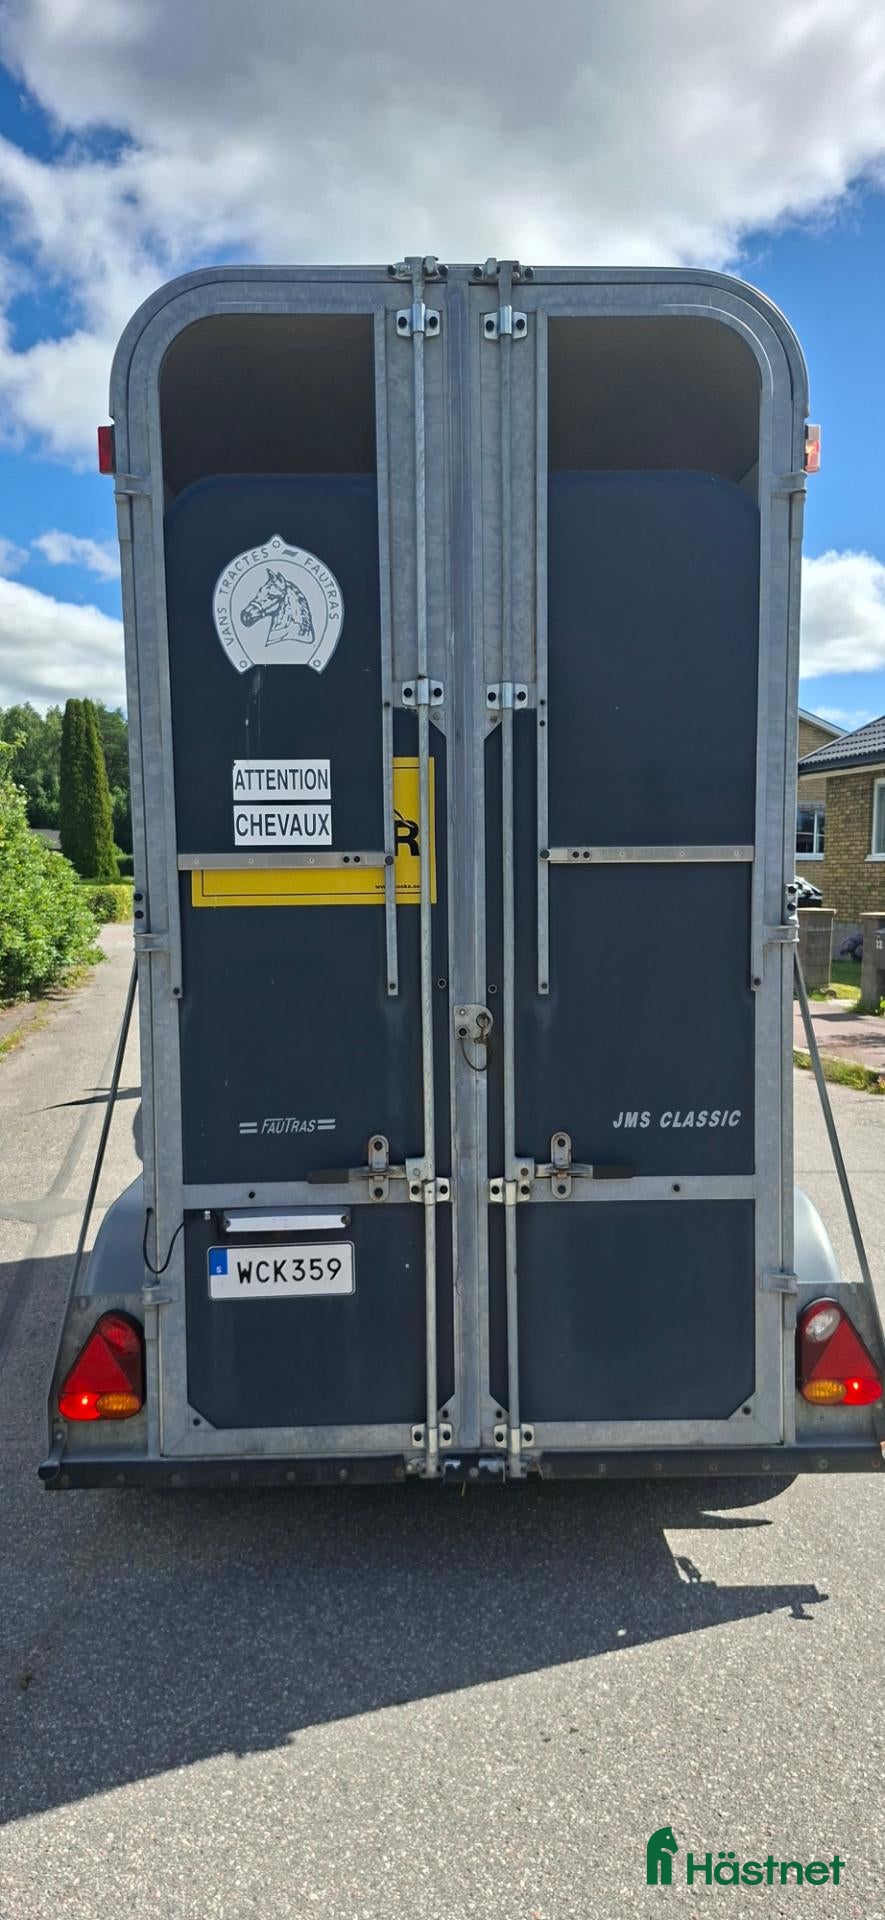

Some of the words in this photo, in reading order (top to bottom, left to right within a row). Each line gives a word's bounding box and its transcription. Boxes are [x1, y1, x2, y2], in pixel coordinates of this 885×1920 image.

[219, 548, 269, 596] TRACTES
[304, 557, 340, 621] FAUTRAS
[217, 607, 235, 647] VANS
[234, 768, 329, 791] ATTENTION
[235, 813, 331, 837] CHEVAUX
[613, 1111, 651, 1129] JMS
[660, 1110, 742, 1128] CLASSIC
[237, 1257, 342, 1285] WCK359
